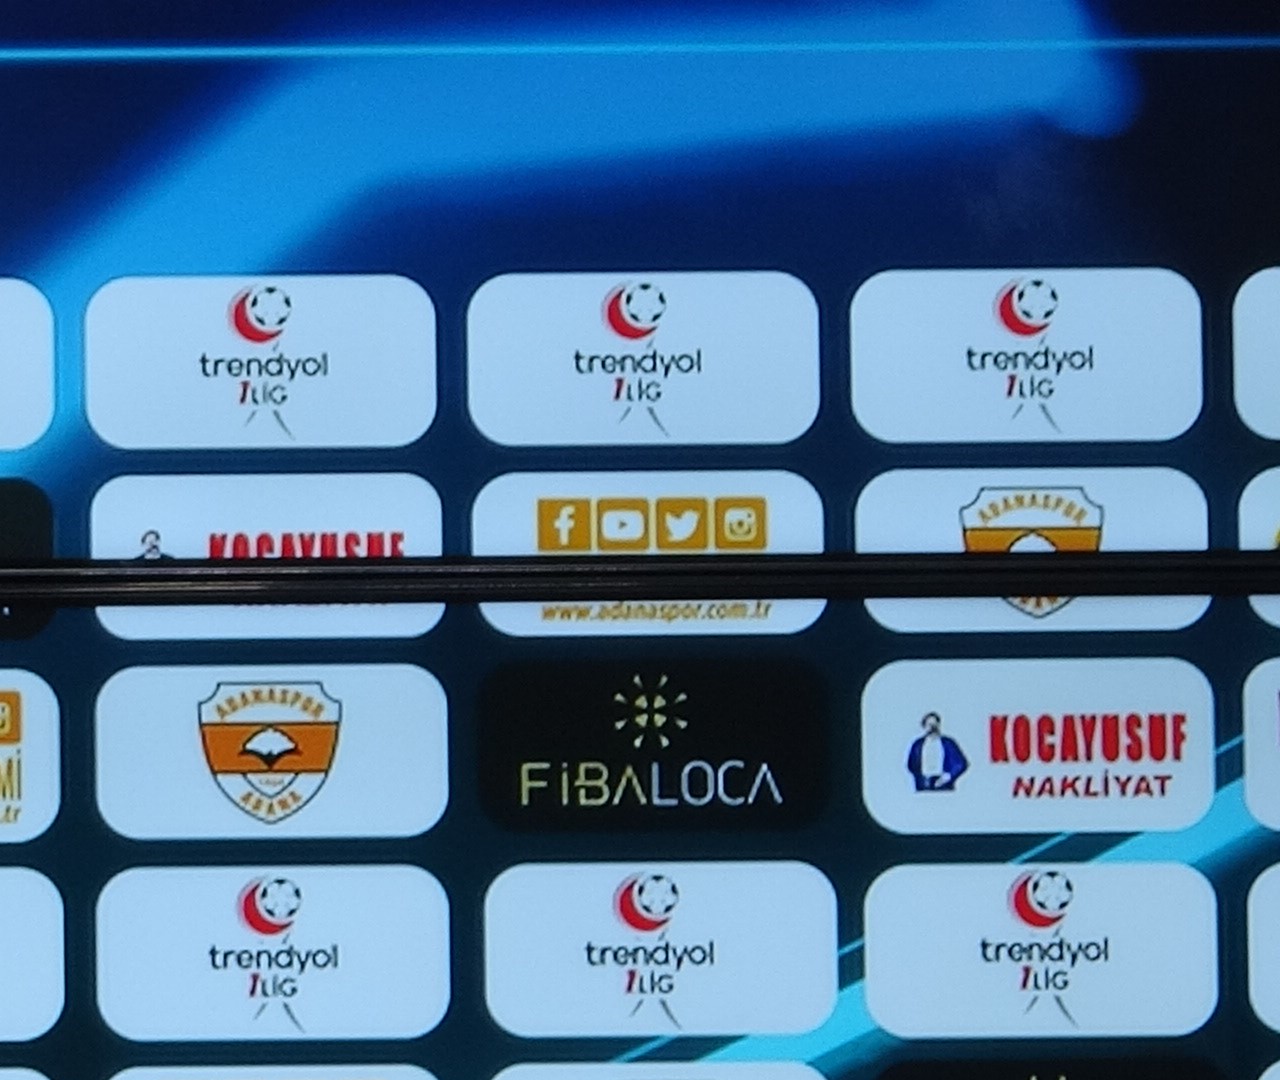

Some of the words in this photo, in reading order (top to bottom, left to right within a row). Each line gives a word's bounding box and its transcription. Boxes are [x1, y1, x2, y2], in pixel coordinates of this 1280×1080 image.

[199, 349, 328, 381] trendyol
[574, 346, 701, 378] trendyol
[966, 343, 1093, 376] trendyol
[989, 713, 1187, 764] KOCAYUSUF
[1012, 770, 1173, 798] NAKLİYAT
[208, 943, 338, 974] trendyol
[585, 937, 714, 971] trendyol
[980, 934, 1109, 967] trendyol
